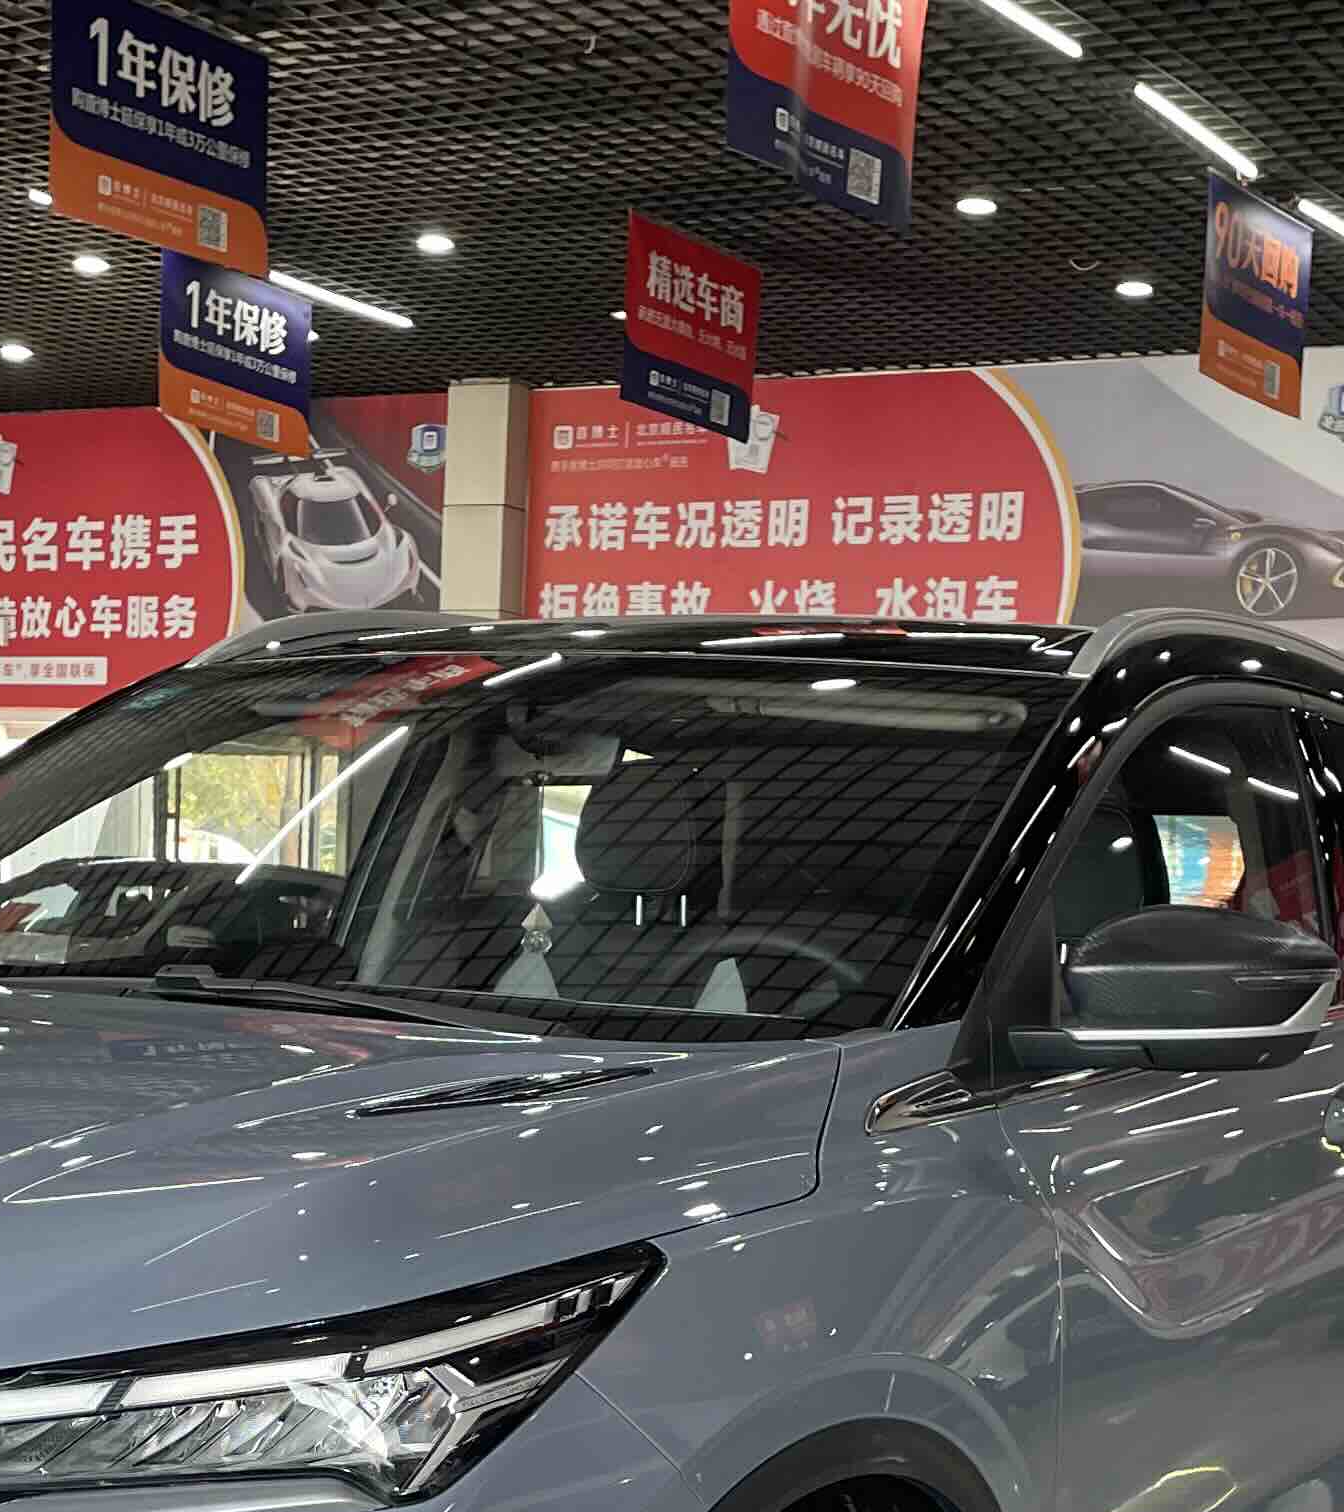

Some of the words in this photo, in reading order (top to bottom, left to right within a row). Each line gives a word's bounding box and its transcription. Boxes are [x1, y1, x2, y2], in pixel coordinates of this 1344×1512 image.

[788, 0, 903, 69] 无忧
[89, 17, 235, 127] 1年保修
[186, 280, 287, 355] 1年保修
[646, 250, 744, 334] 精选车商
[544, 499, 810, 552] 承诺车况透明
[831, 491, 1025, 545] 记录透明
[539, 581, 712, 619] 拒绝事故
[749, 579, 838, 617] 火烧
[875, 576, 1020, 622] 水泡车
